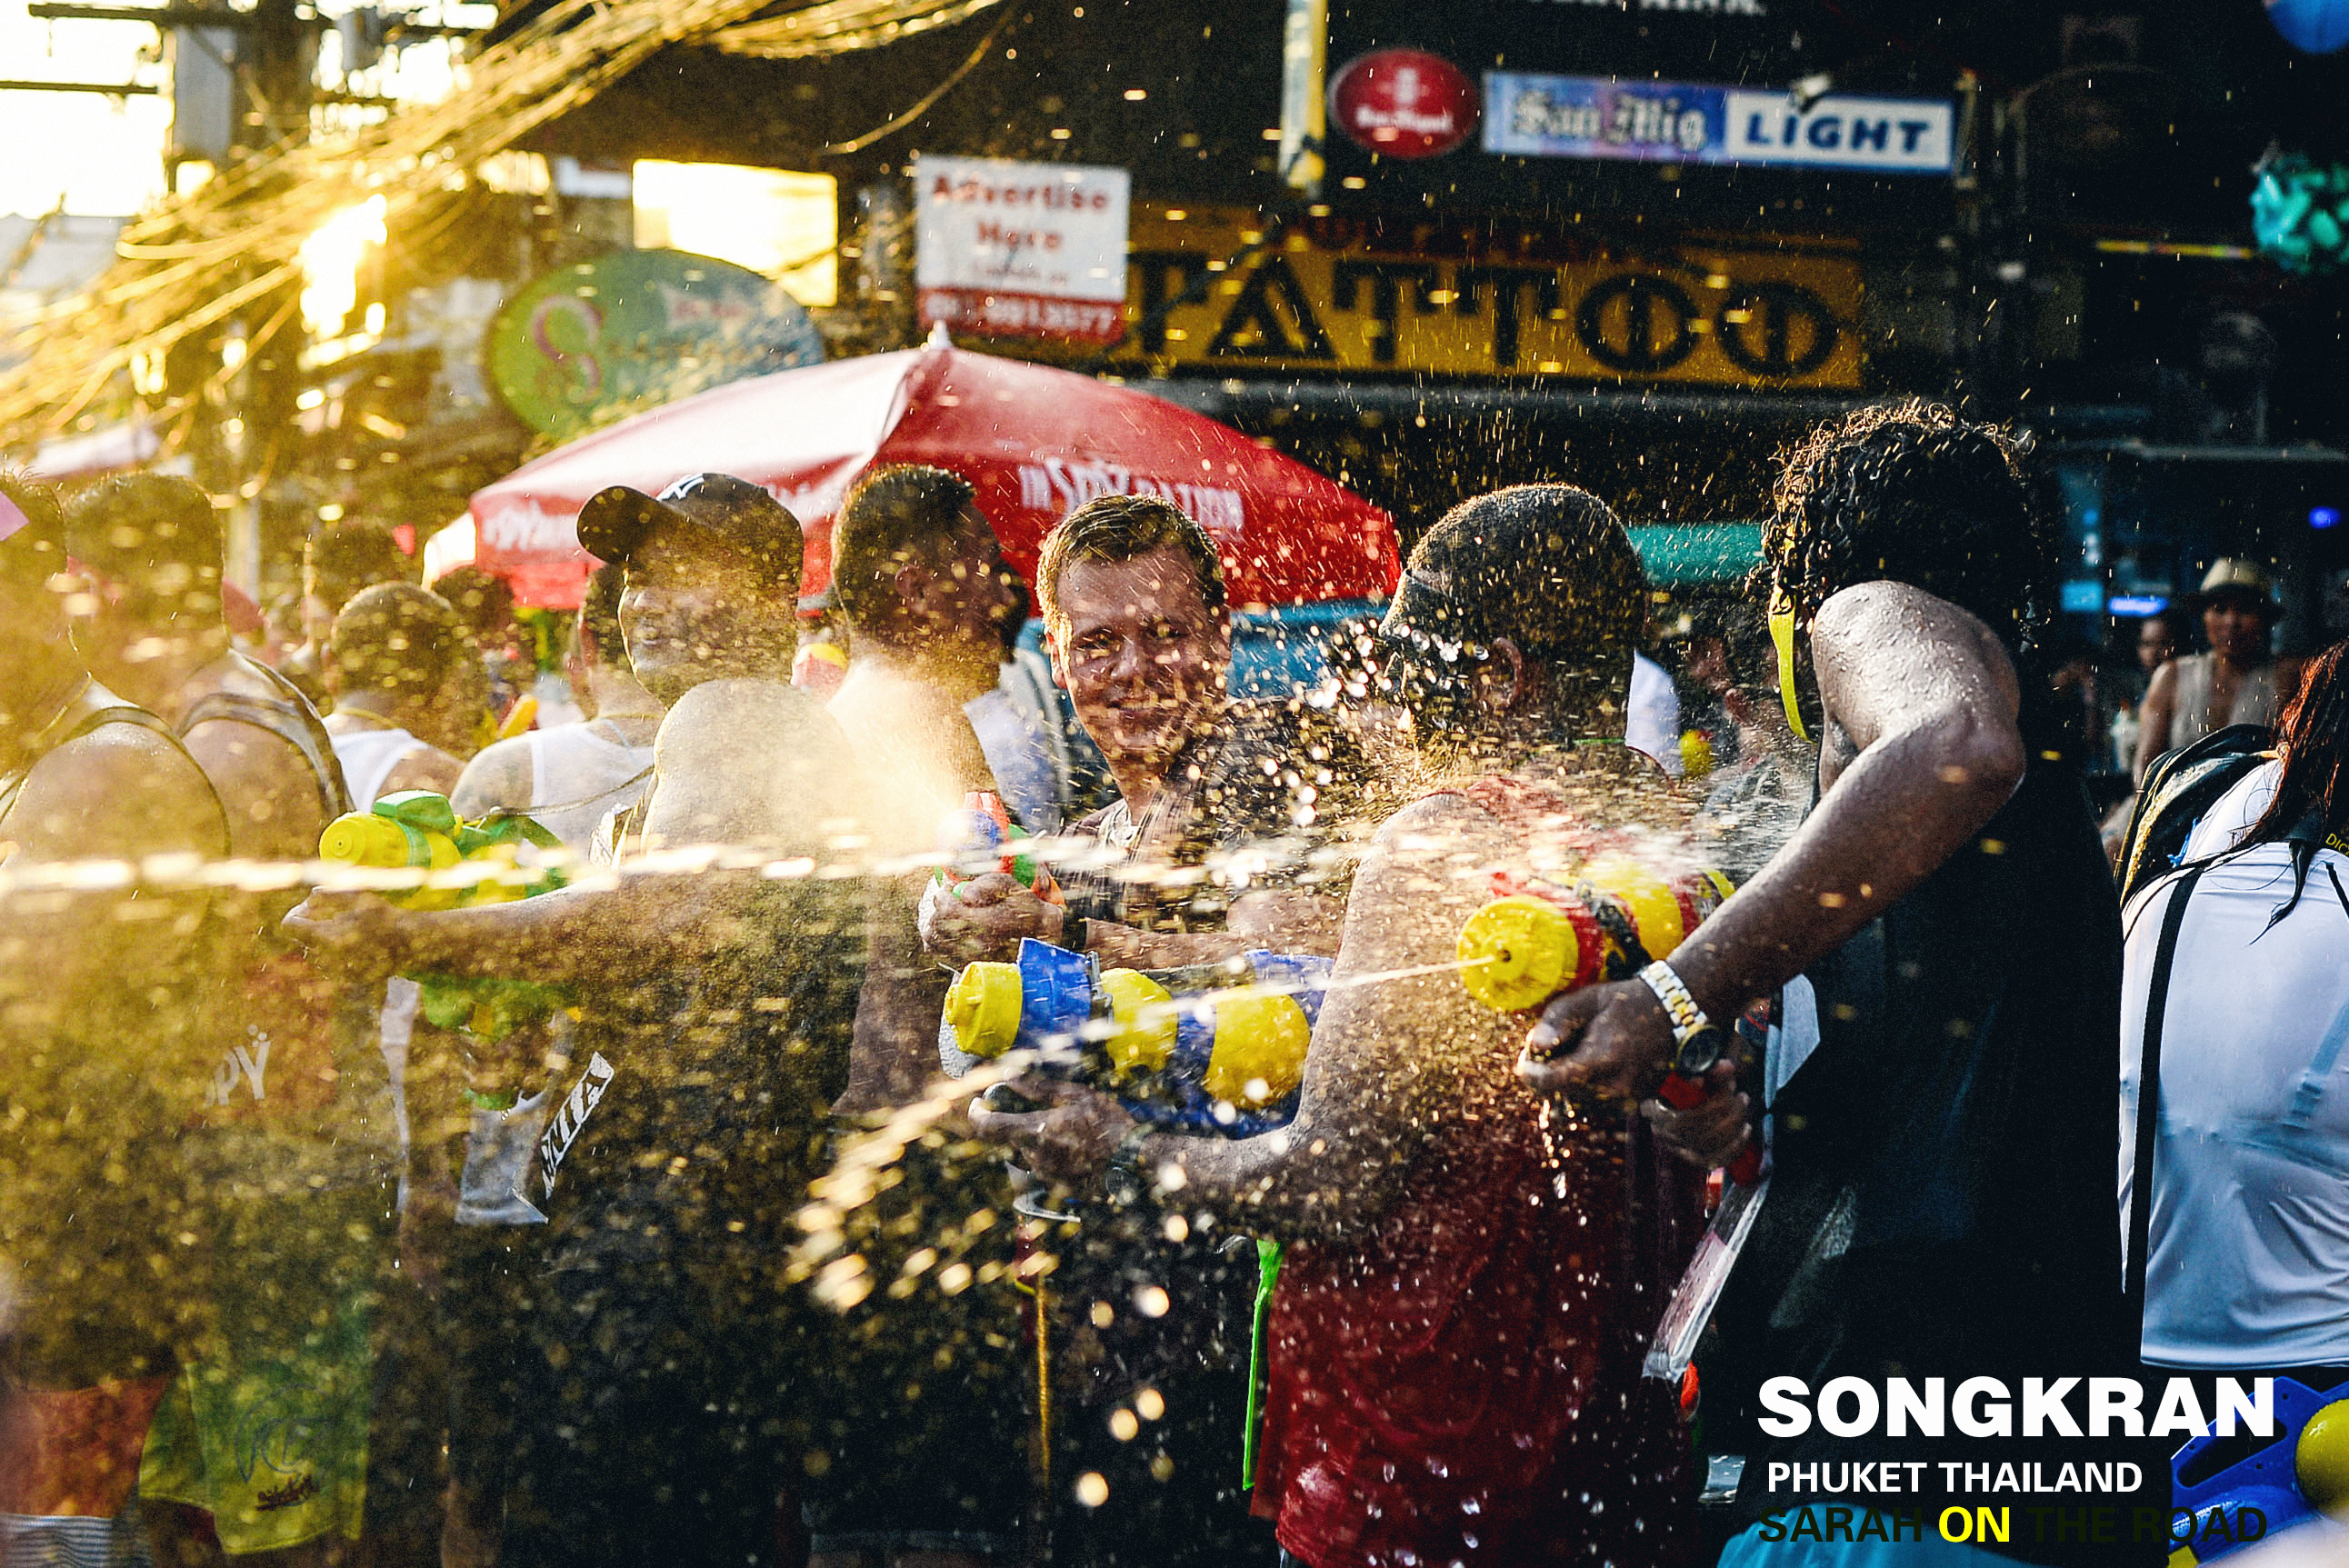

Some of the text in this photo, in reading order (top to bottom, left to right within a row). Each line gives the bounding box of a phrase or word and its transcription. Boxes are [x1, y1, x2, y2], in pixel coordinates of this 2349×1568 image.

[1746, 112, 1930, 153] LIGHT
[932, 174, 1109, 210] Advertise
[977, 219, 1063, 251] Here
